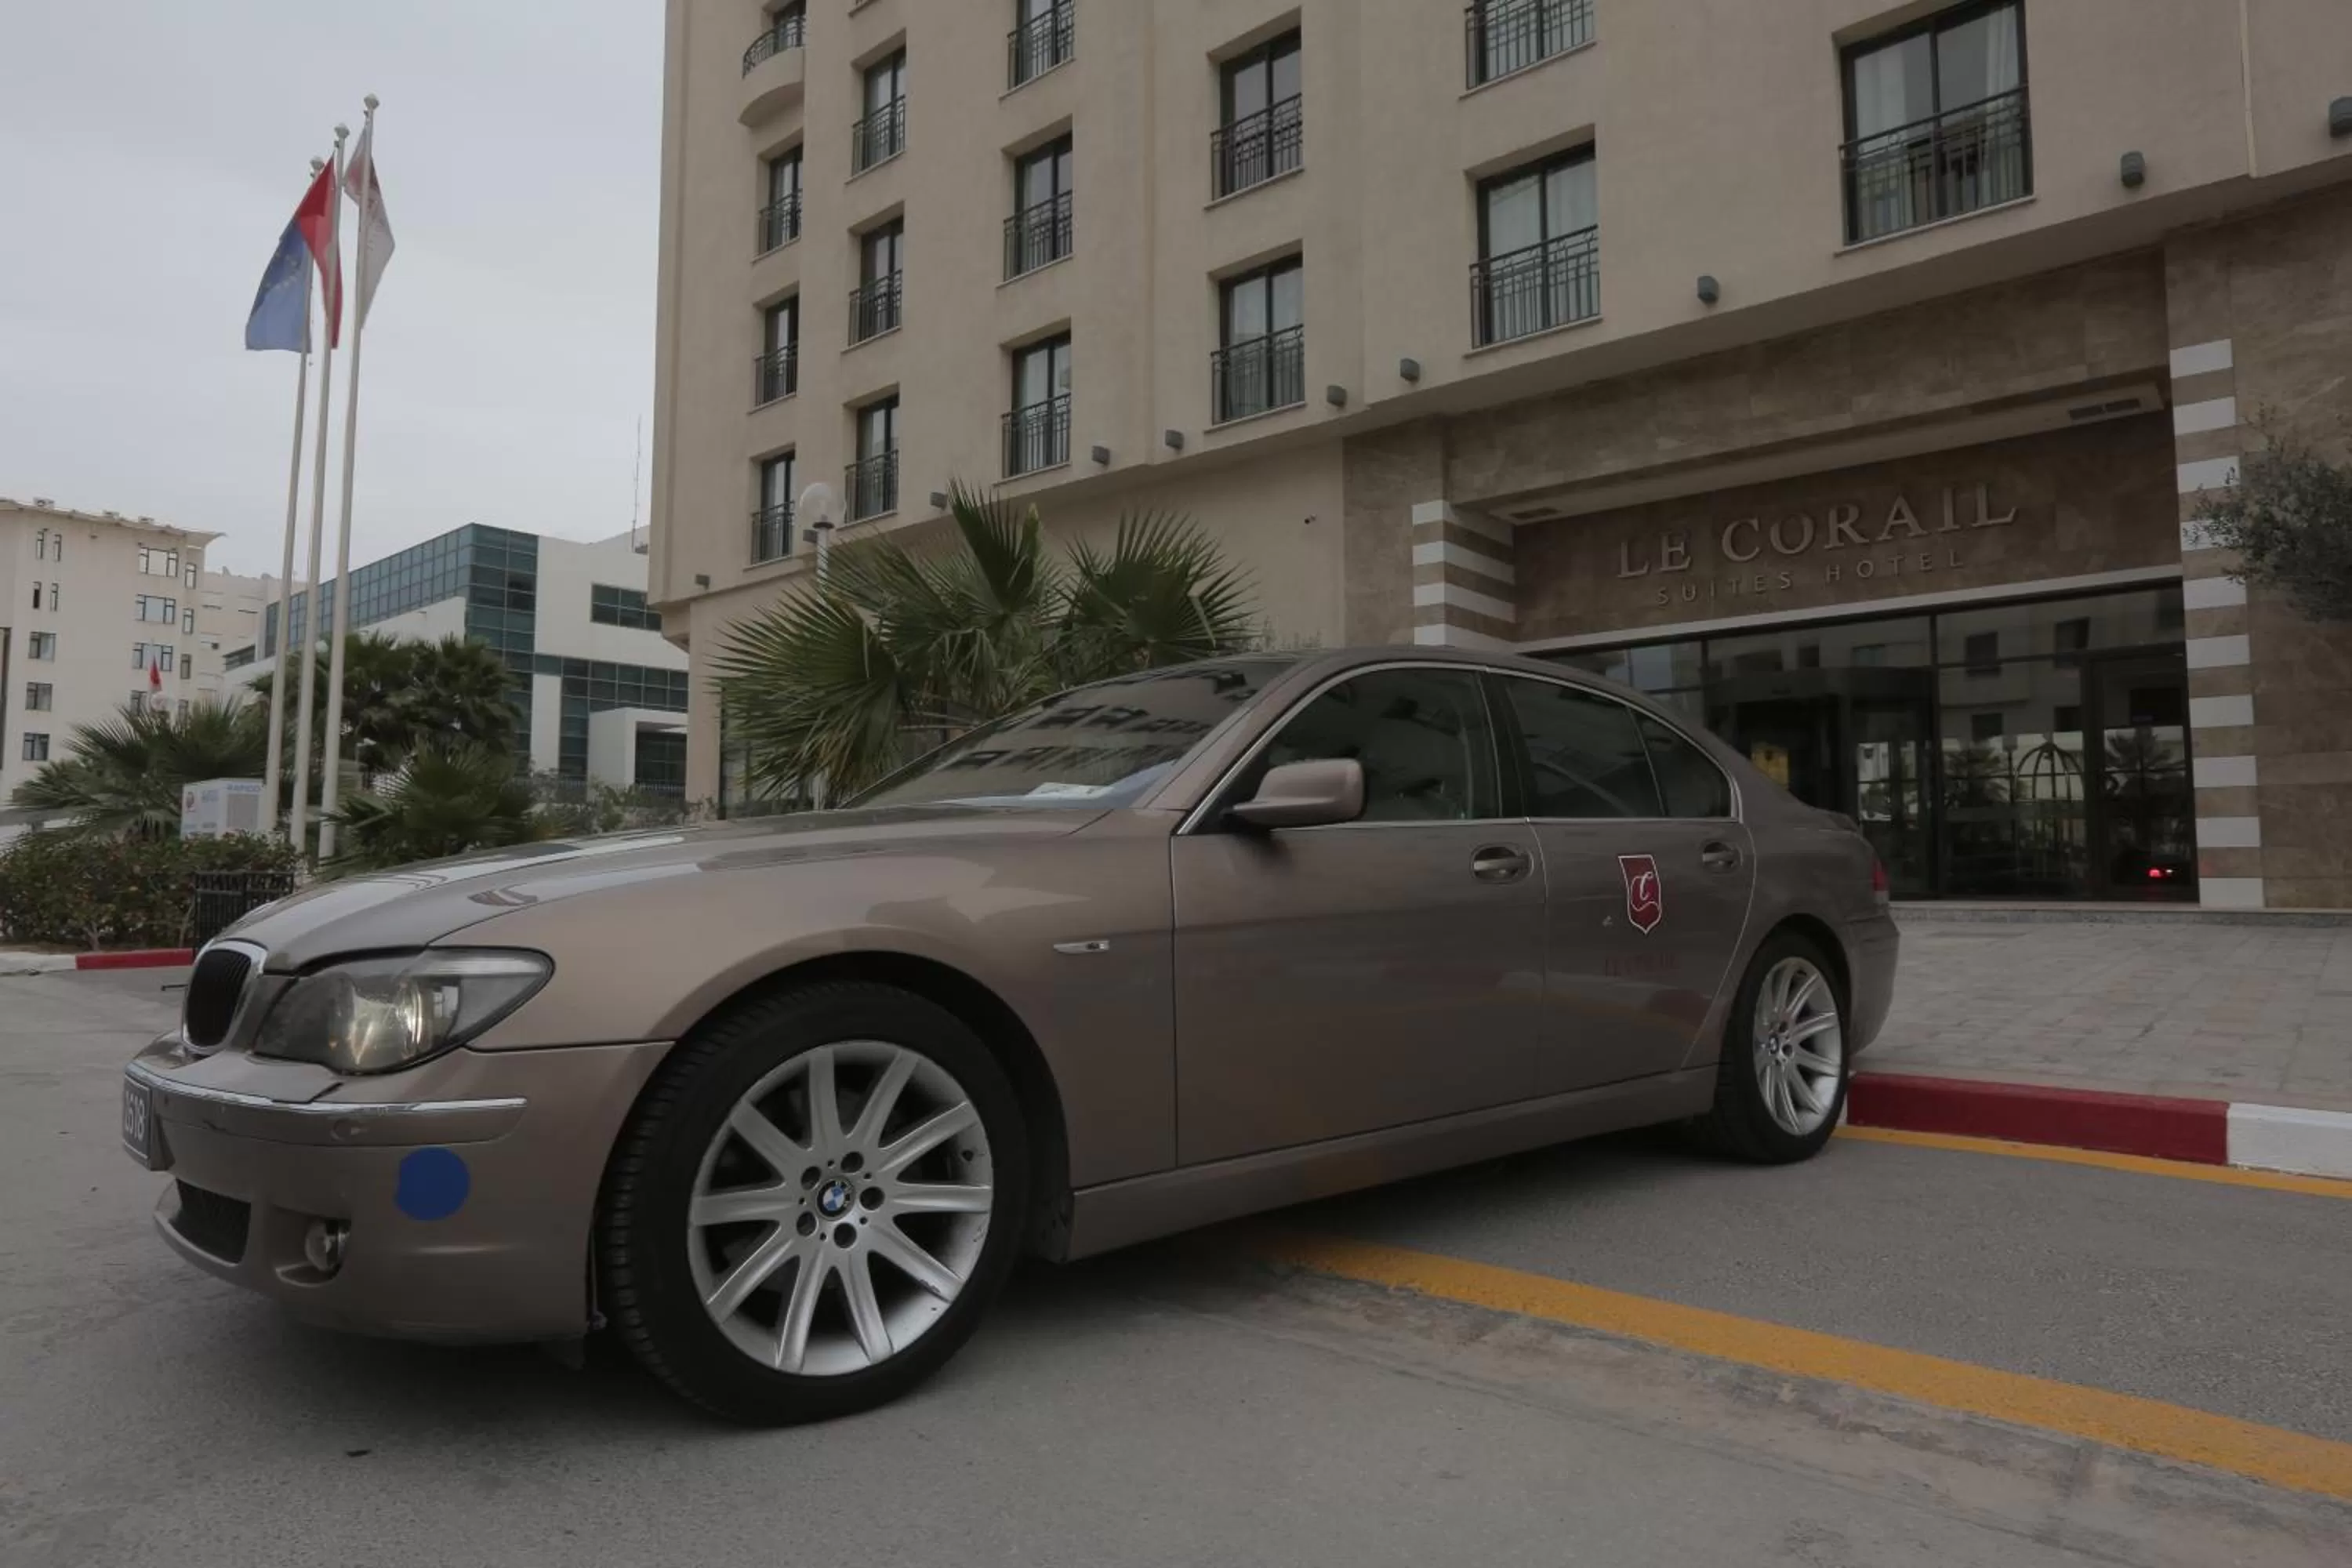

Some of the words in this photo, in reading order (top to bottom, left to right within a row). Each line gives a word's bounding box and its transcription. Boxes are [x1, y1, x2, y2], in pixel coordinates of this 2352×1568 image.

[1617, 532, 1692, 579] LE
[1722, 482, 2017, 563] CORAIL
[1657, 572, 1794, 606] SUITES
[1826, 550, 1965, 583] HOTEL
